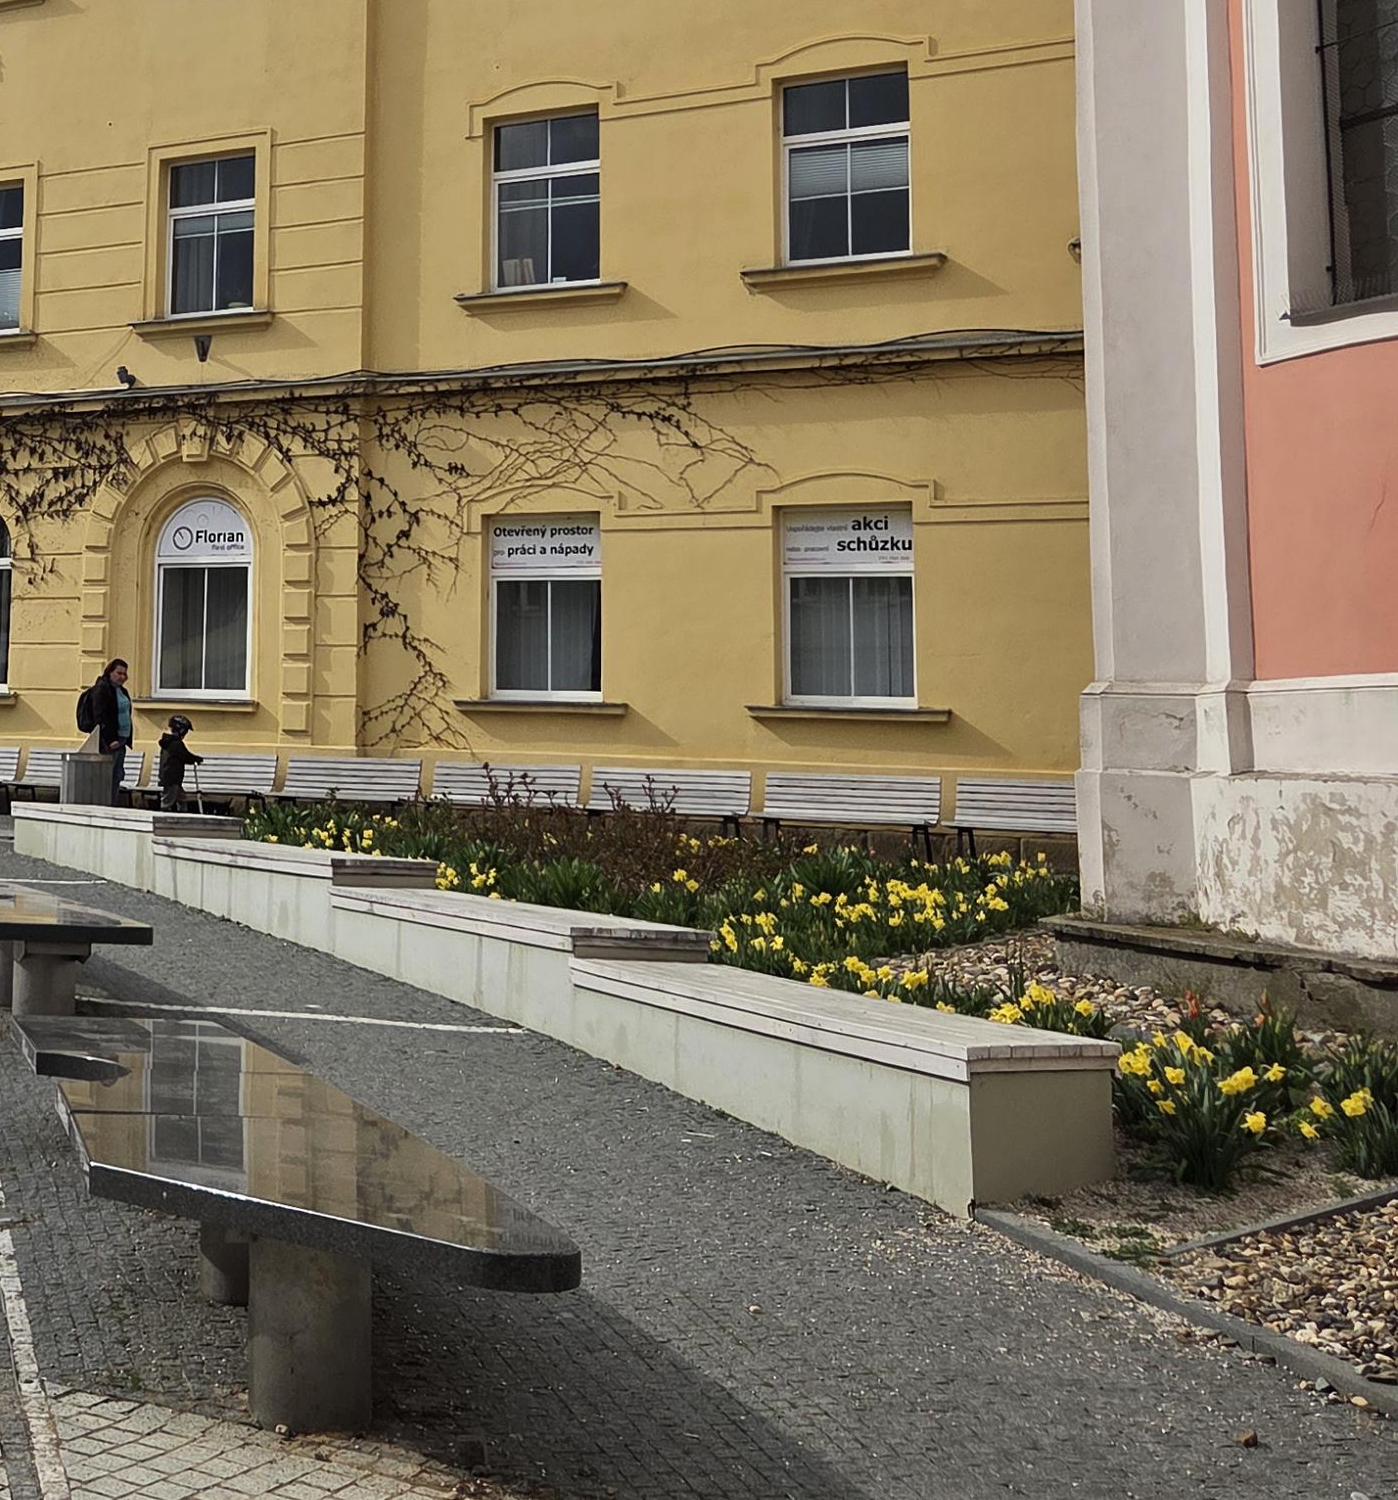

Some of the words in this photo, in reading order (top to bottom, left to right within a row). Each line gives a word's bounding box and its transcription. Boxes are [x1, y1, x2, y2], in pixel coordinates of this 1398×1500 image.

[851, 515, 889, 531] akci
[195, 529, 244, 544] Florian
[493, 524, 547, 539] Otevřený
[550, 525, 594, 538] prostor
[507, 543, 536, 558] práci
[539, 545, 547, 555] a
[550, 542, 594, 556] nápady
[836, 534, 913, 552] schůzku
